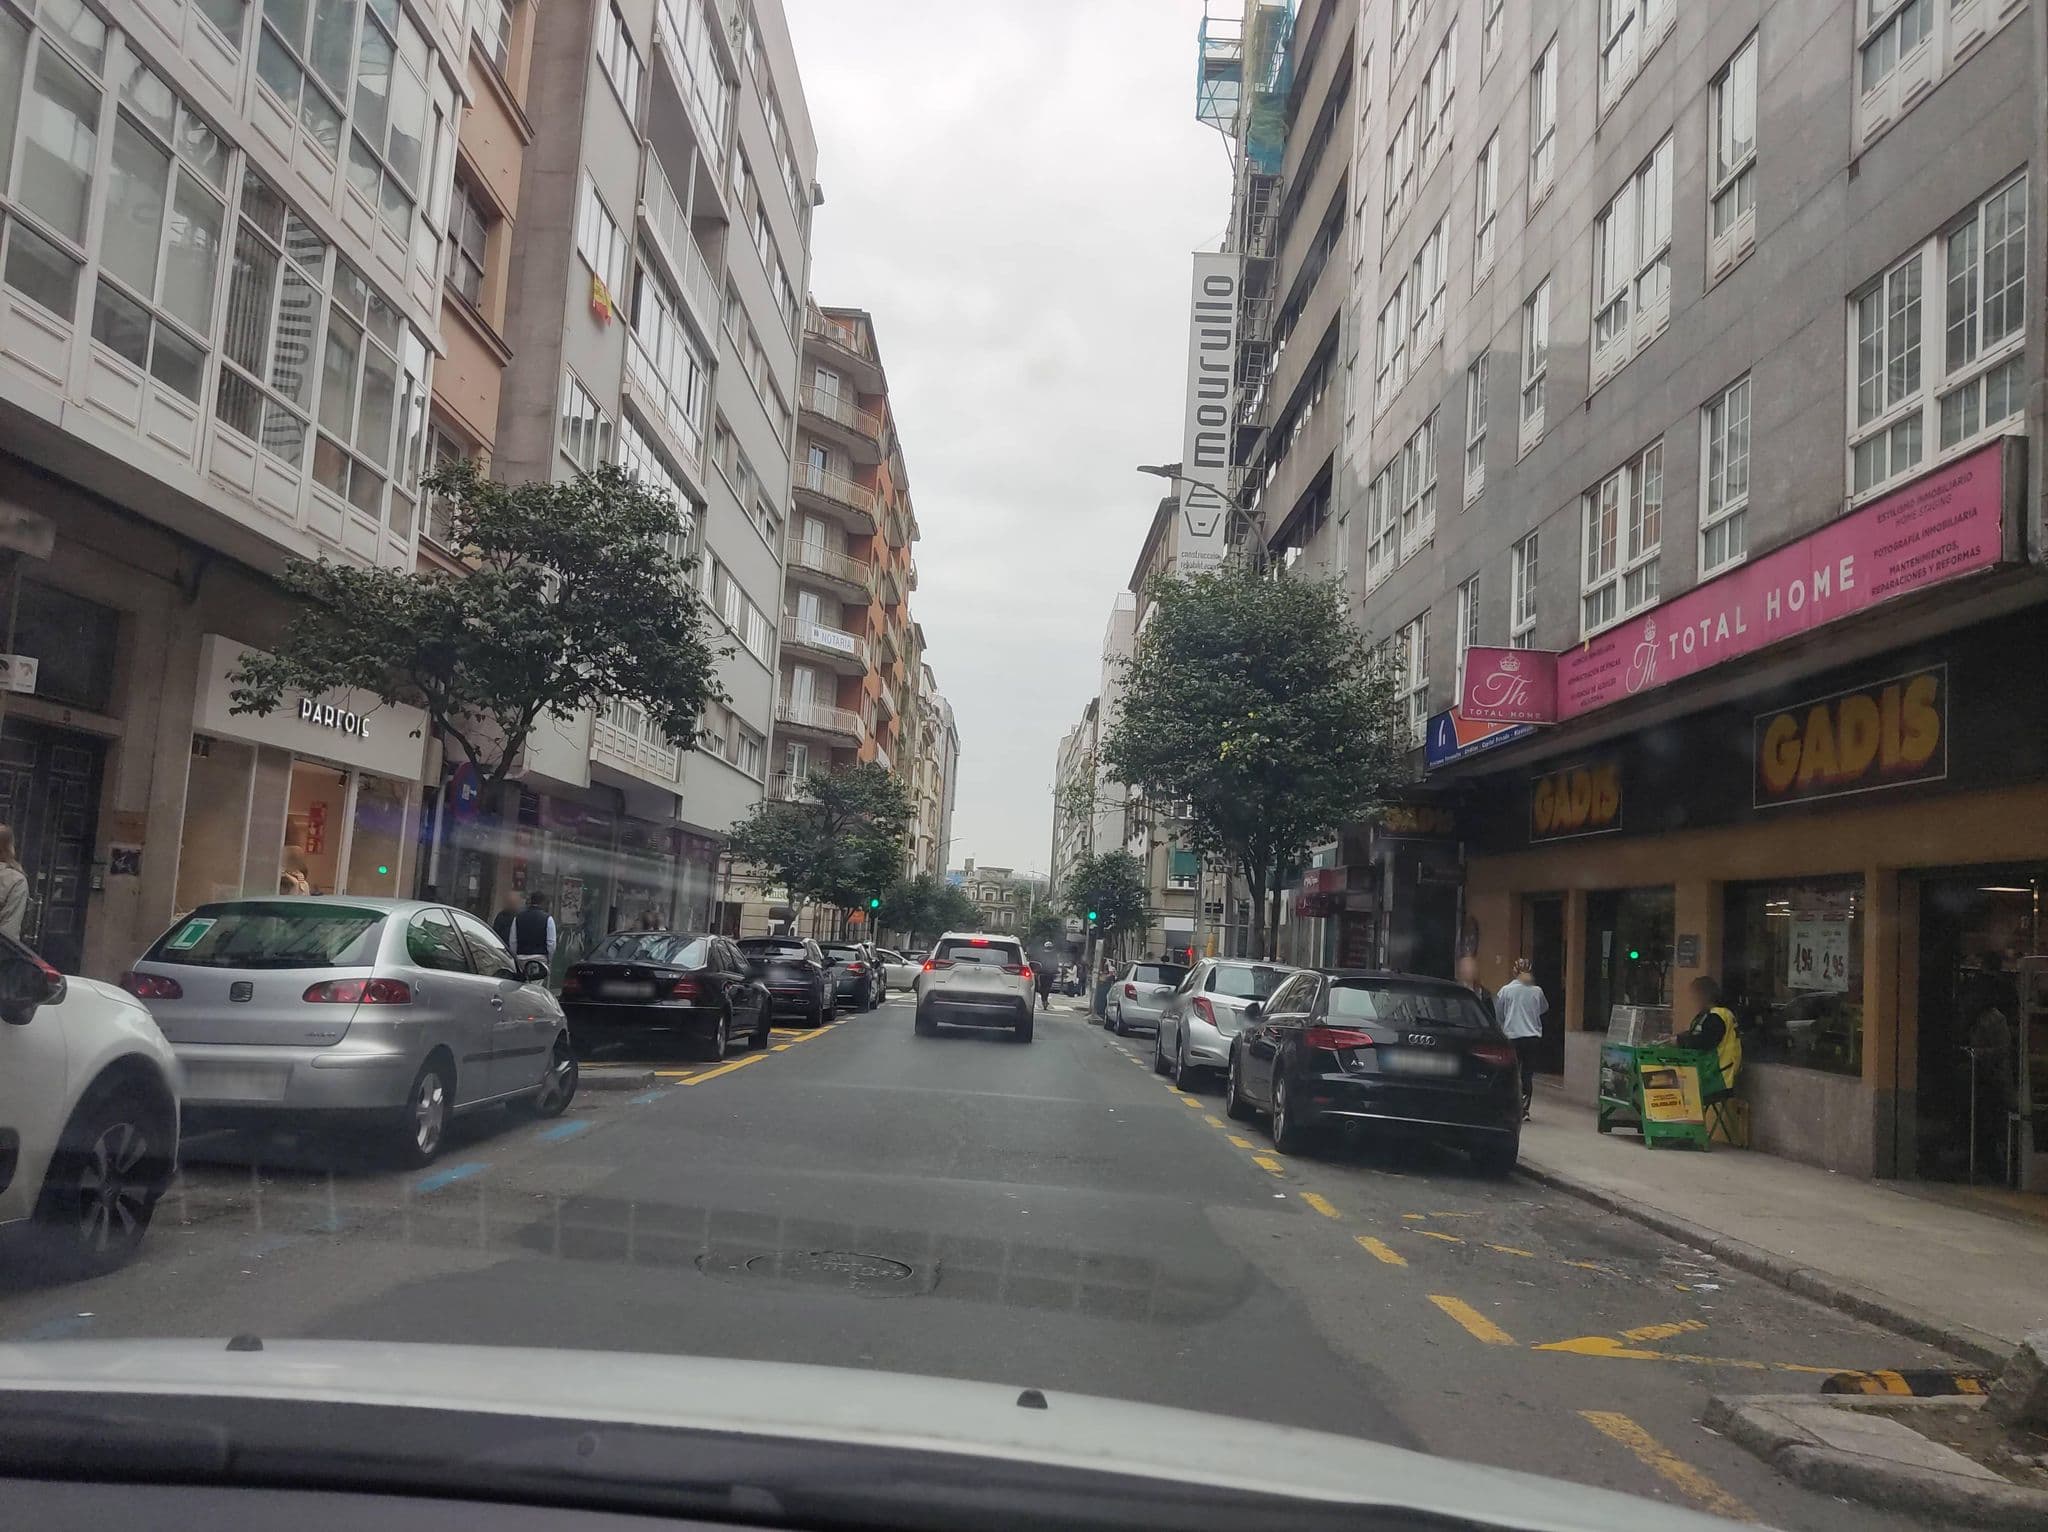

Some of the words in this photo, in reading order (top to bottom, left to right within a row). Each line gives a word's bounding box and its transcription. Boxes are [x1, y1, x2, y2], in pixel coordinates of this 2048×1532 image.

[1194, 275, 1233, 468] mourullo
[1918, 471, 1973, 502] INMOBILIARIO
[1921, 507, 1978, 538] INMOBILIARIA
[1871, 567, 1927, 596] REPARACIONES
[1936, 545, 1981, 570] REFORMAS
[1669, 607, 1747, 660] TOTAL
[1767, 555, 1855, 622] HOME
[300, 698, 370, 738] PARFOIS
[1469, 708, 1503, 718] TOTAL
[1763, 675, 1940, 790] GADIS
[1534, 765, 1617, 833] GADIS
